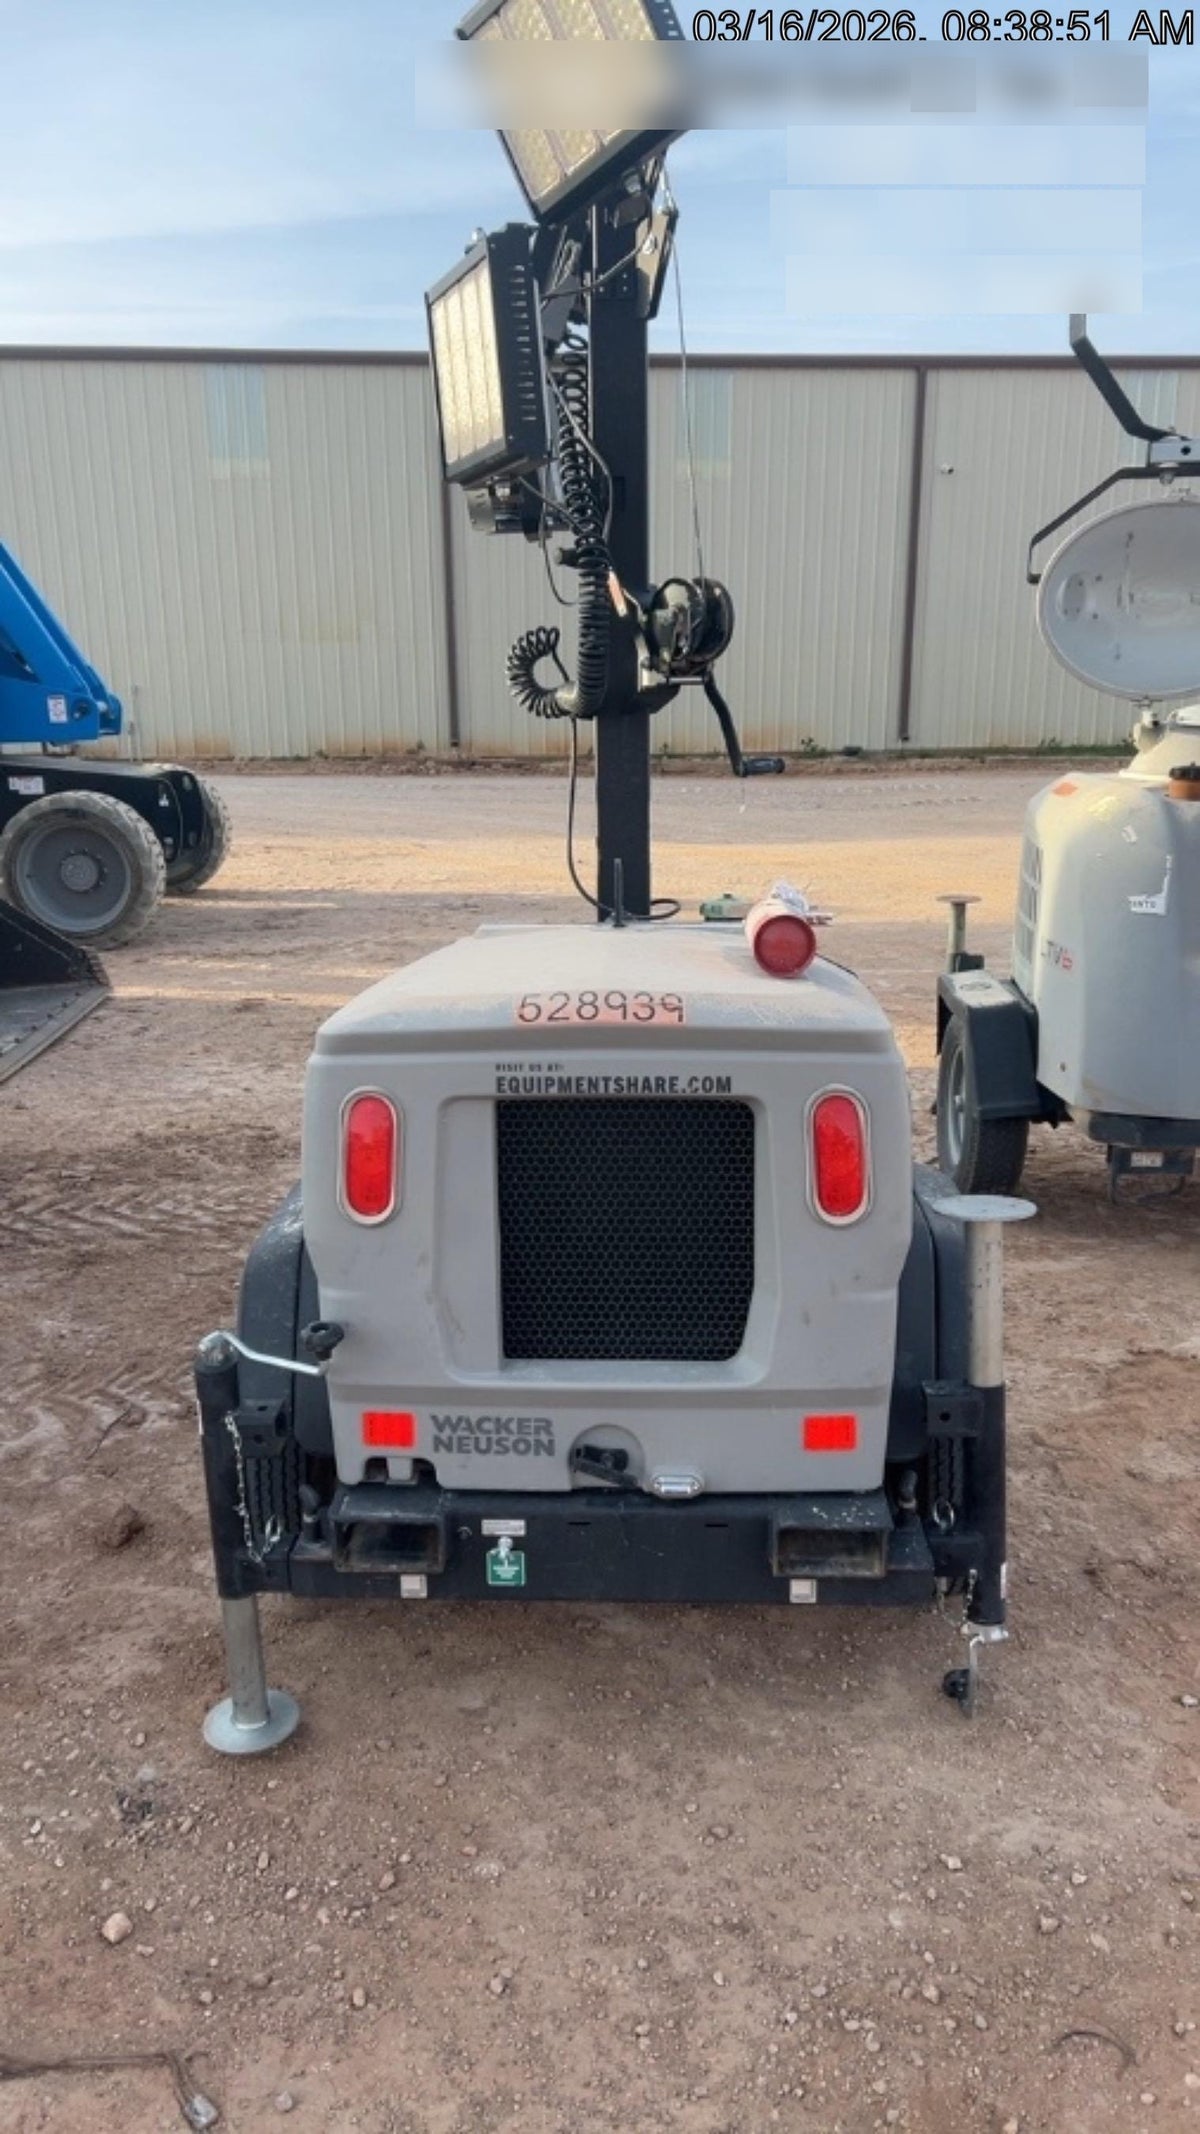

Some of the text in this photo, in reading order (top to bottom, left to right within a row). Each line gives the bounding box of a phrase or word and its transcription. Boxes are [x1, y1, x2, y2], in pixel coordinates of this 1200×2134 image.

[518, 990, 684, 1023] 528939
[495, 1063, 523, 1072] VISIT
[529, 1063, 542, 1072] US
[495, 1076, 732, 1094] EQUIPMENTSHARE.COM
[430, 1415, 554, 1436] WACKER
[433, 1435, 556, 1457] NEUSON
